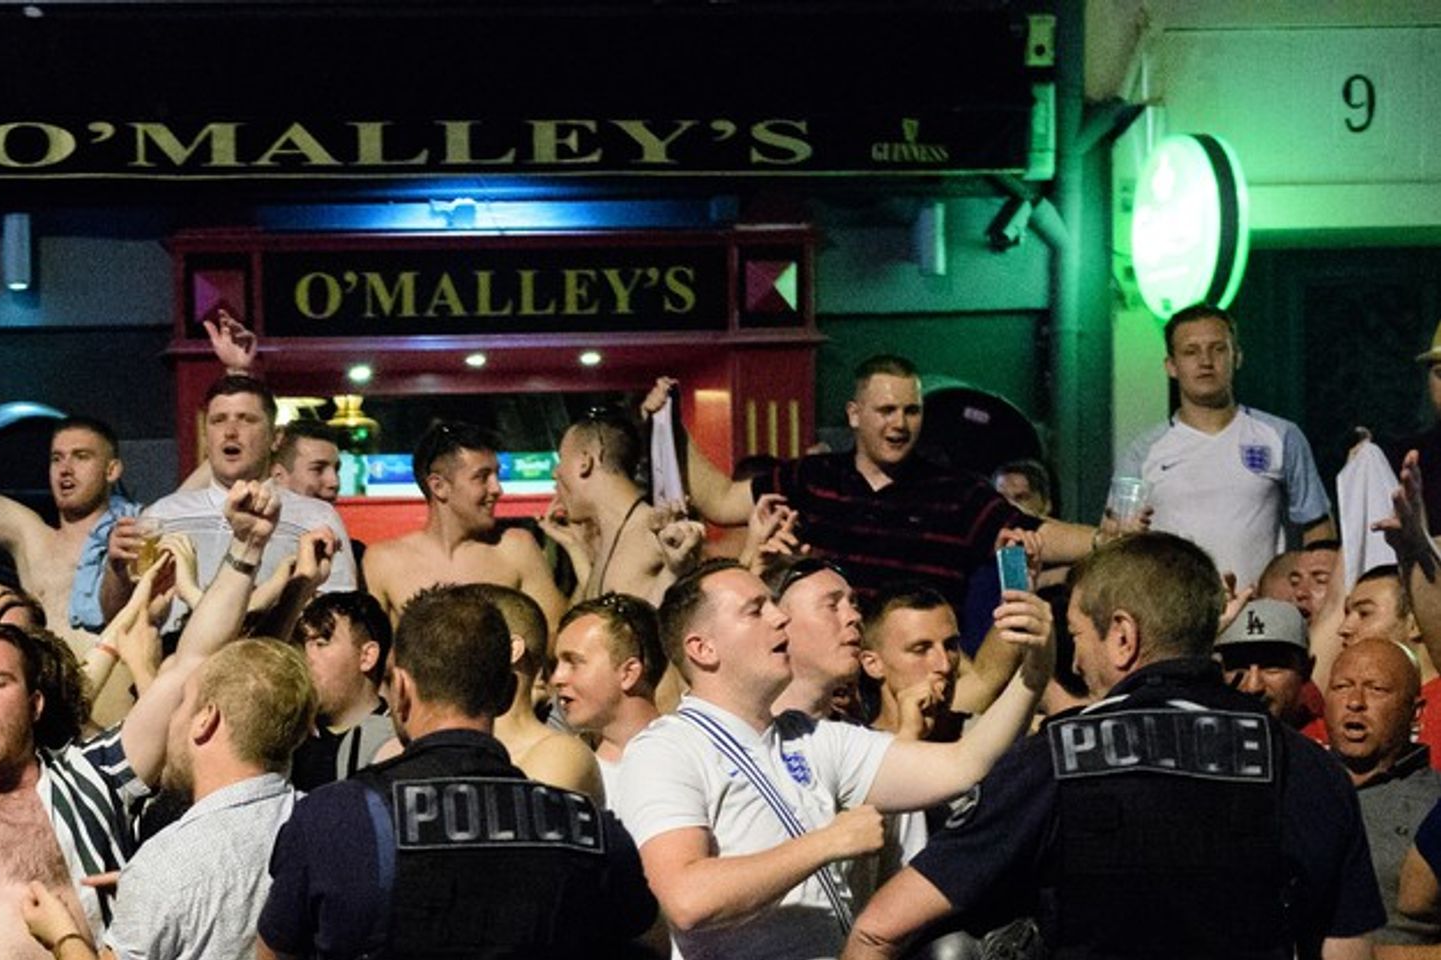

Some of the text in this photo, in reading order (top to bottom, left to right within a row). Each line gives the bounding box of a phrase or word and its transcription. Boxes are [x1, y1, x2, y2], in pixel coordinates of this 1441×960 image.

[1342, 74, 1375, 133] 9
[294, 266, 696, 320] O'MALLEY'S
[1061, 716, 1263, 775] POLICE
[405, 783, 595, 846] POLICE
